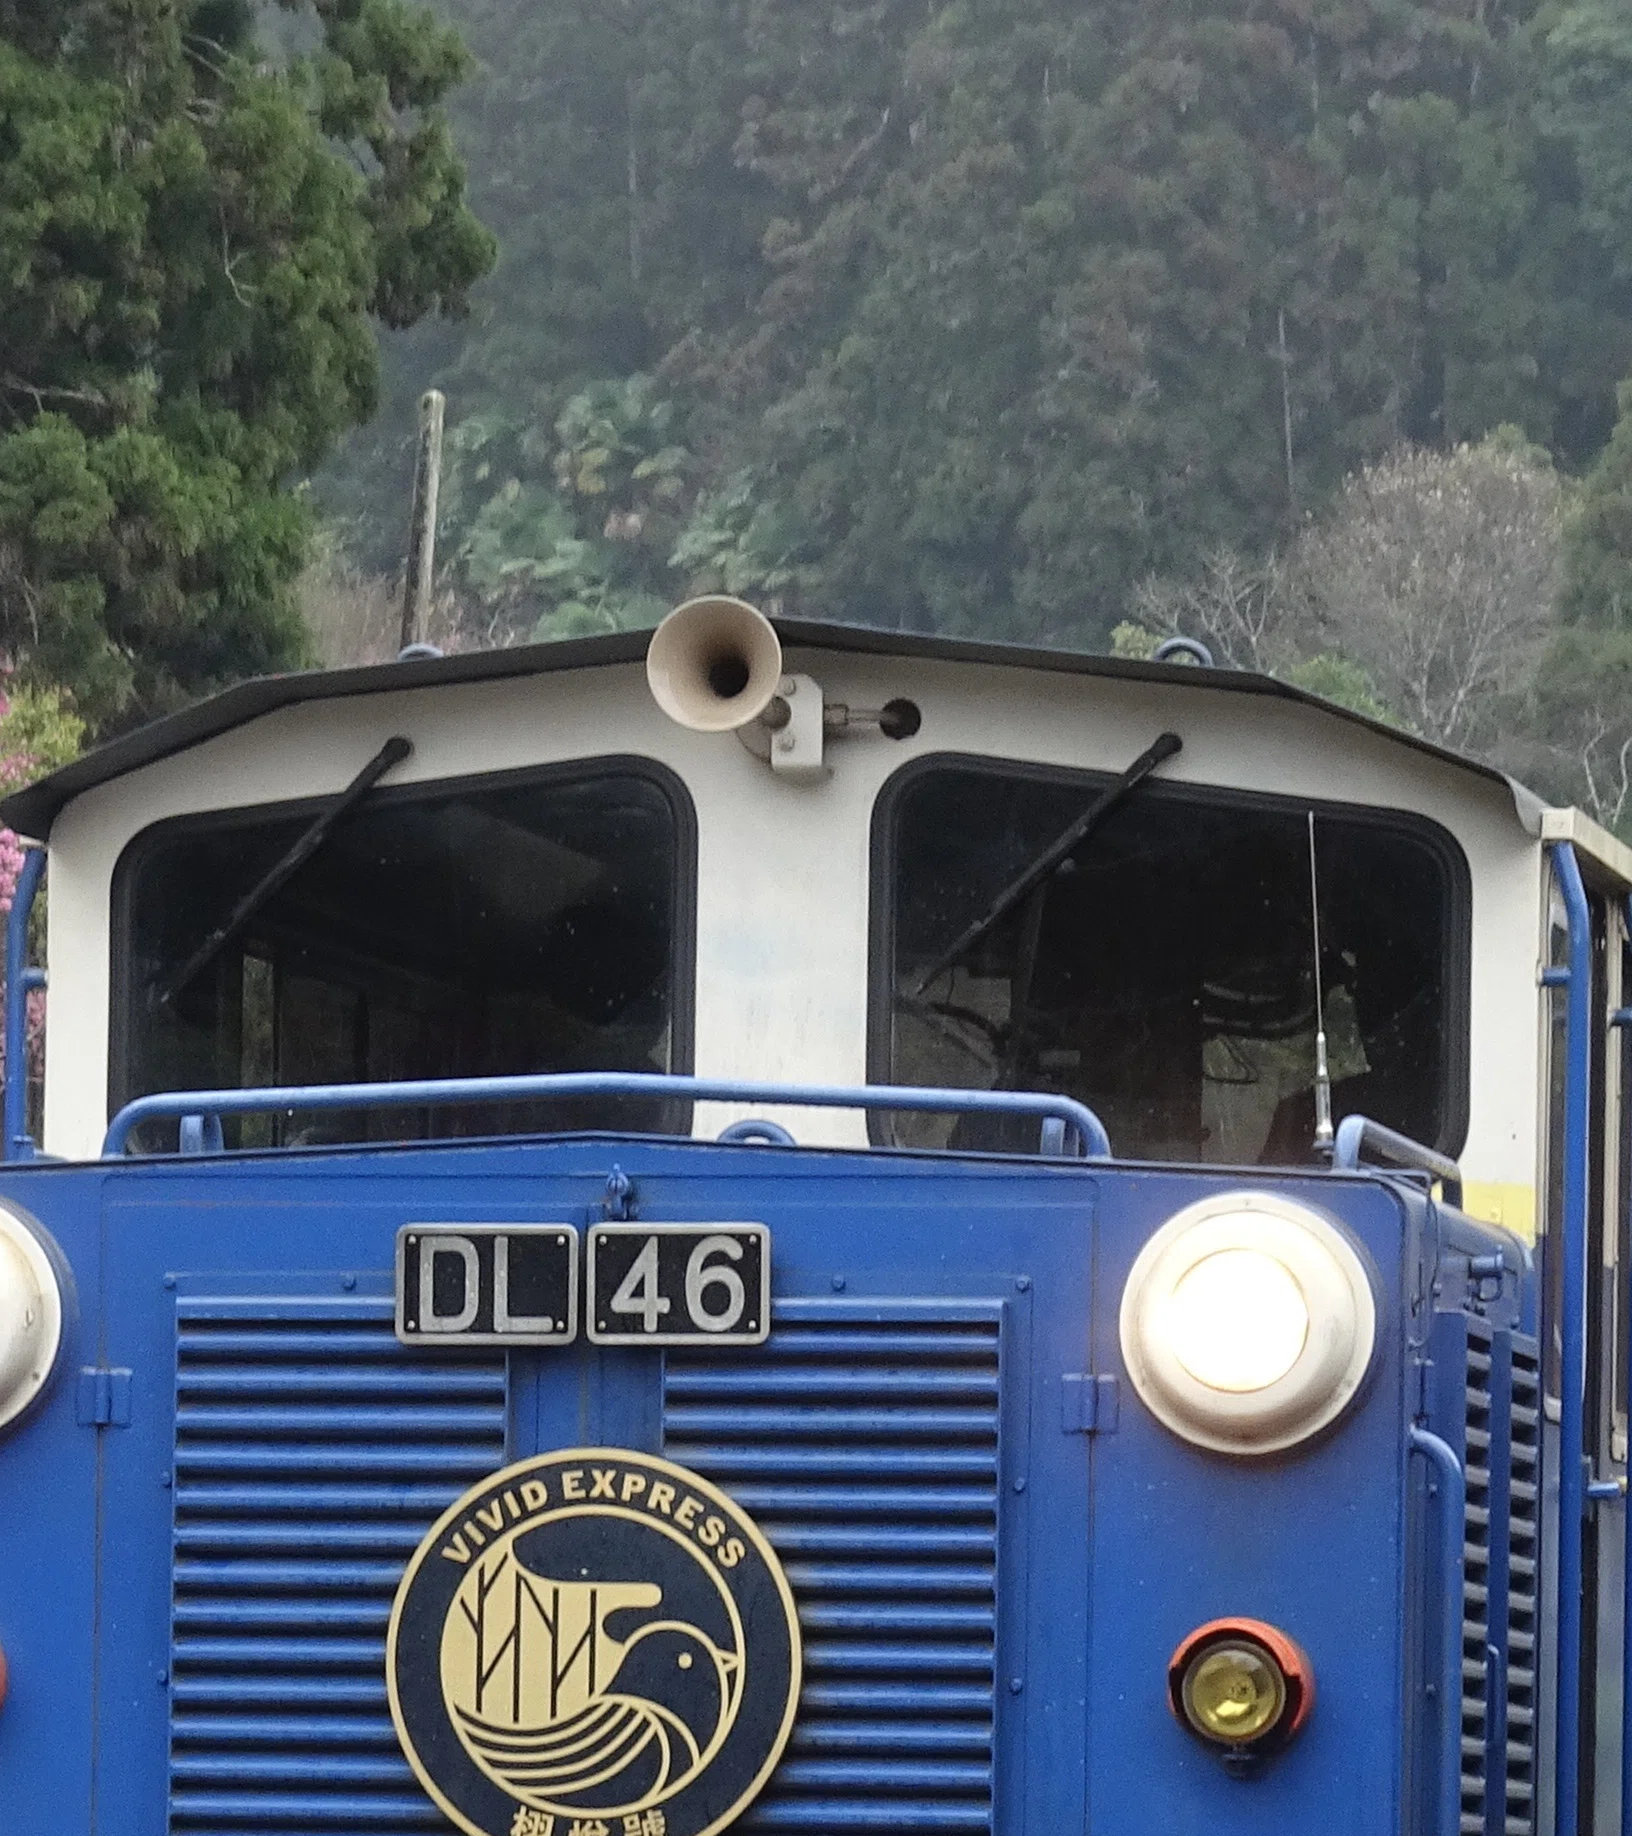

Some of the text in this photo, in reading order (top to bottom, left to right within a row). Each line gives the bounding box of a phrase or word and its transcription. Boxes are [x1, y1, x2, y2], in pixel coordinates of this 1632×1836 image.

[419, 1235, 745, 1333] DL 46
[441, 1469, 746, 1568] VIVID EXPRESS
